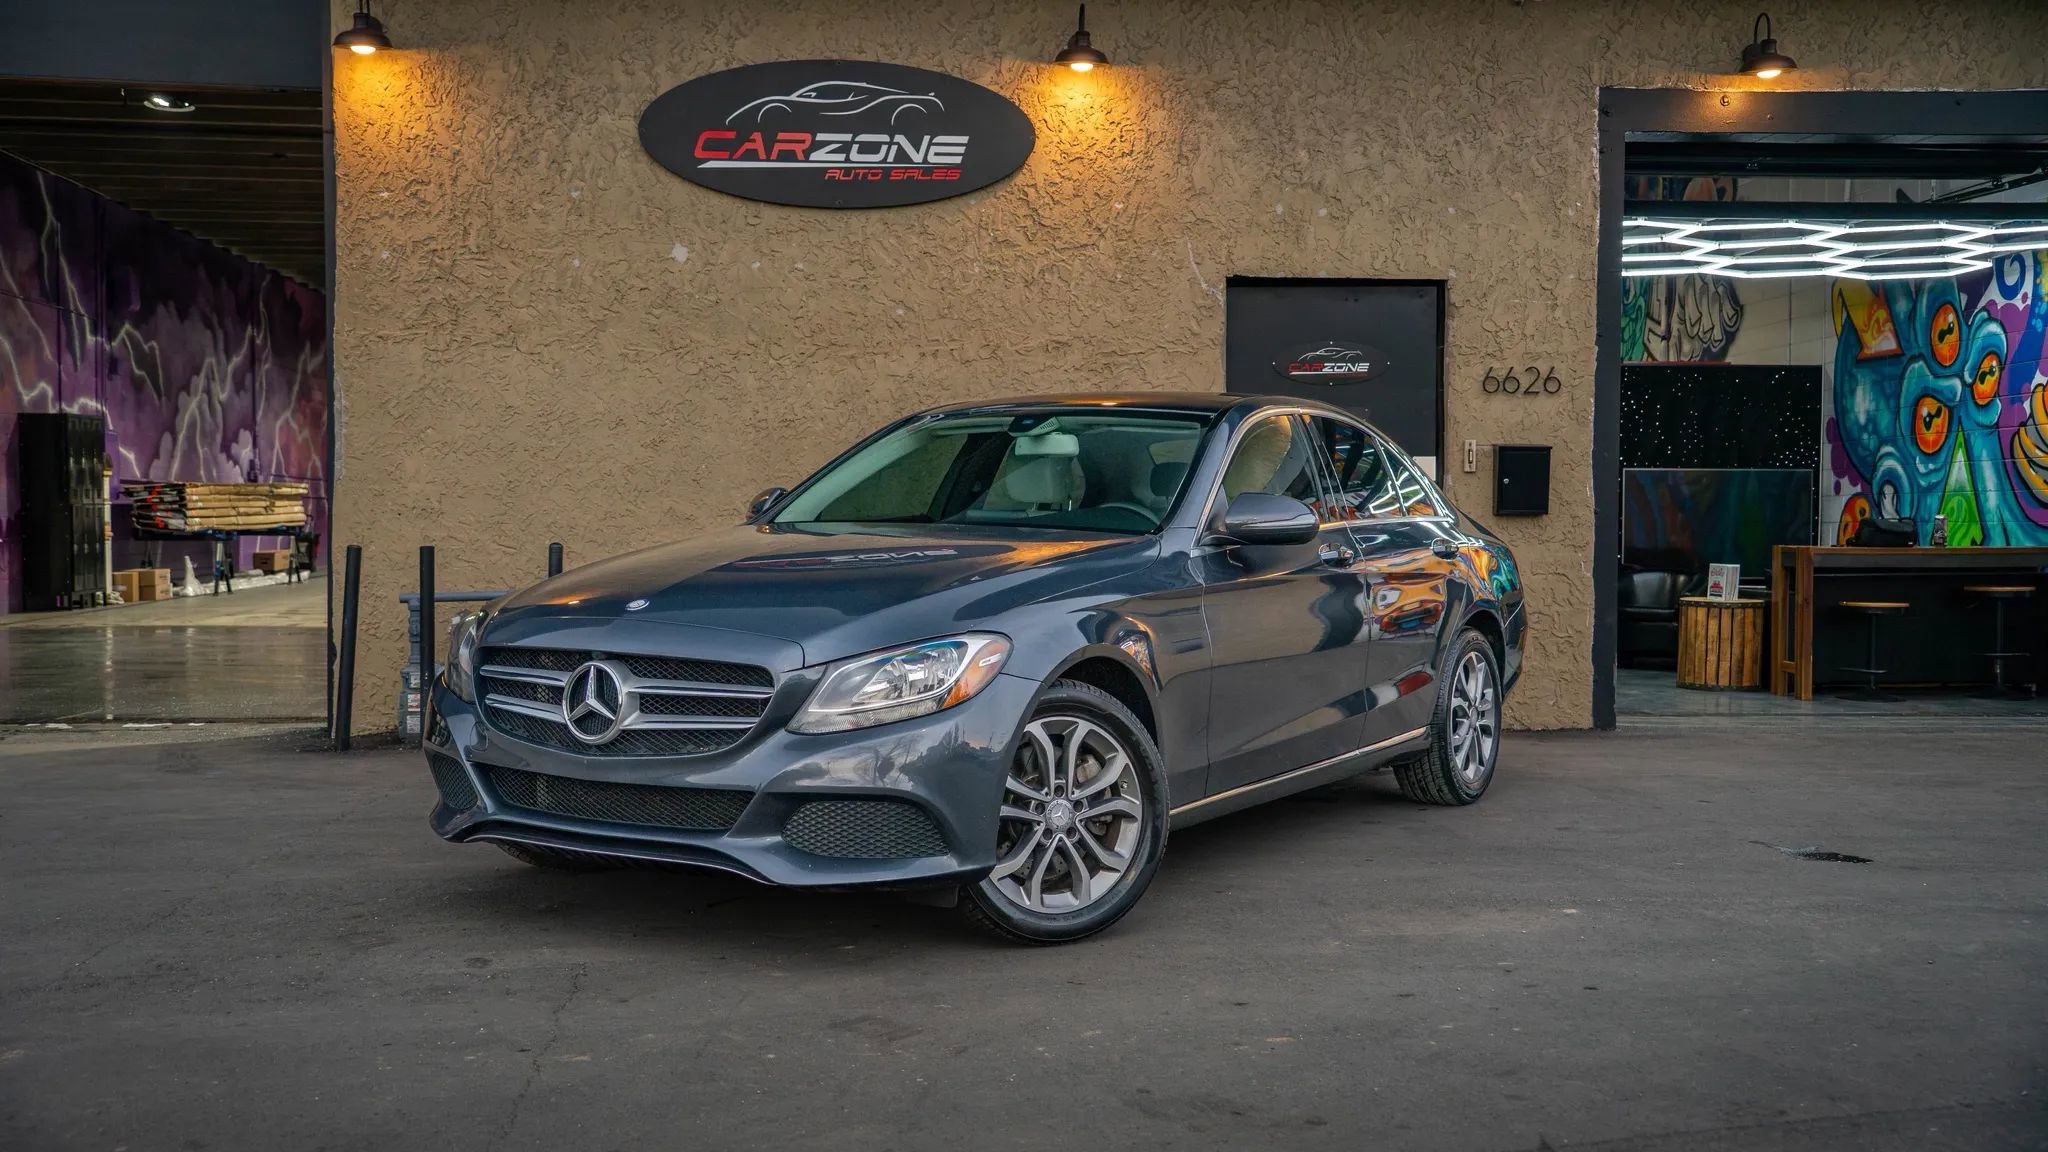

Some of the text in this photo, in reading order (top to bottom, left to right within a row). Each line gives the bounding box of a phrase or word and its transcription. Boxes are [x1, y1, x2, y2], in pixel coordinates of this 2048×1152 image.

[694, 131, 969, 164] CARZONE
[824, 169, 961, 181] AUTO SALES
[1288, 362, 1370, 372] CARZONE
[1482, 366, 1562, 395] 6626
